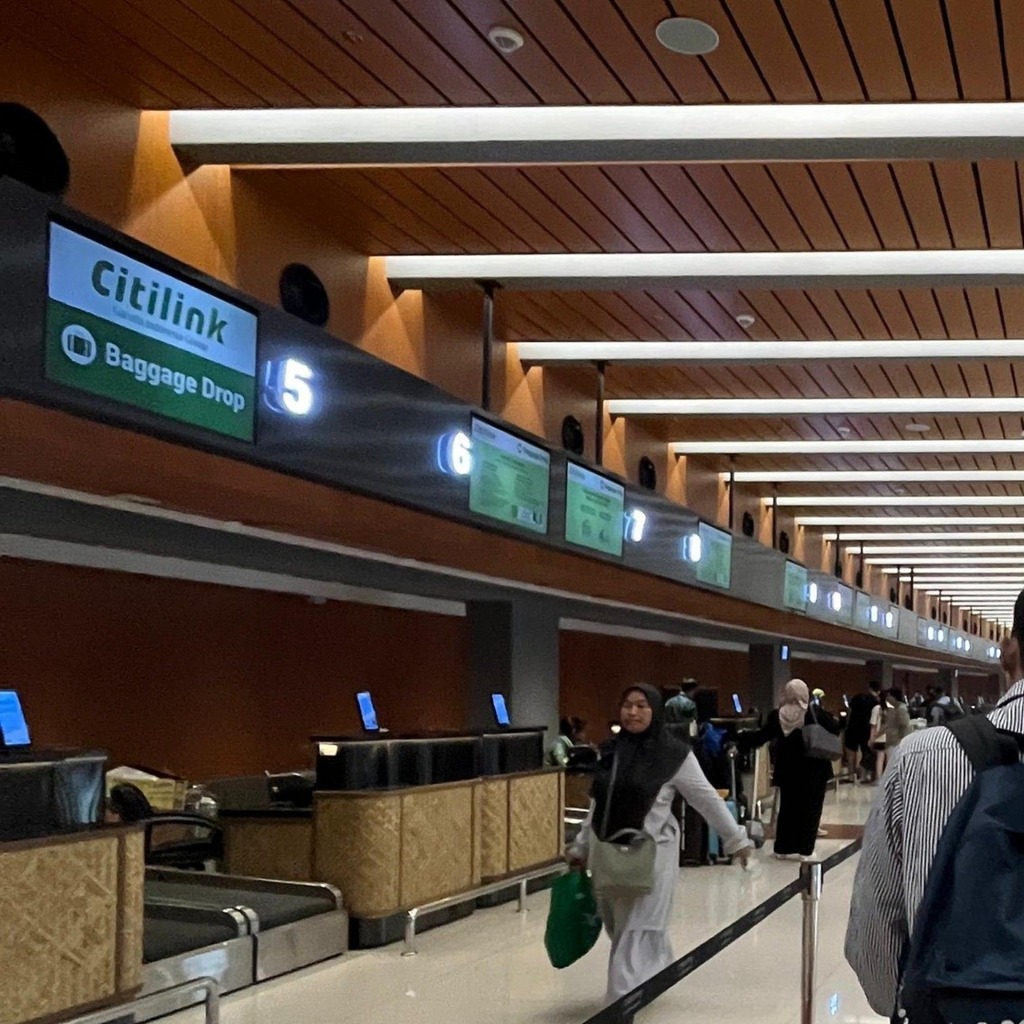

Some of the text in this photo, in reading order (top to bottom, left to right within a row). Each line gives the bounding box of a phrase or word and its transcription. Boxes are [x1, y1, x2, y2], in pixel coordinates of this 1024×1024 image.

[91, 259, 228, 345] Citilink
[105, 342, 246, 413] Baggage Drop
[280, 357, 314, 416] 5
[451, 431, 472, 475] 6
